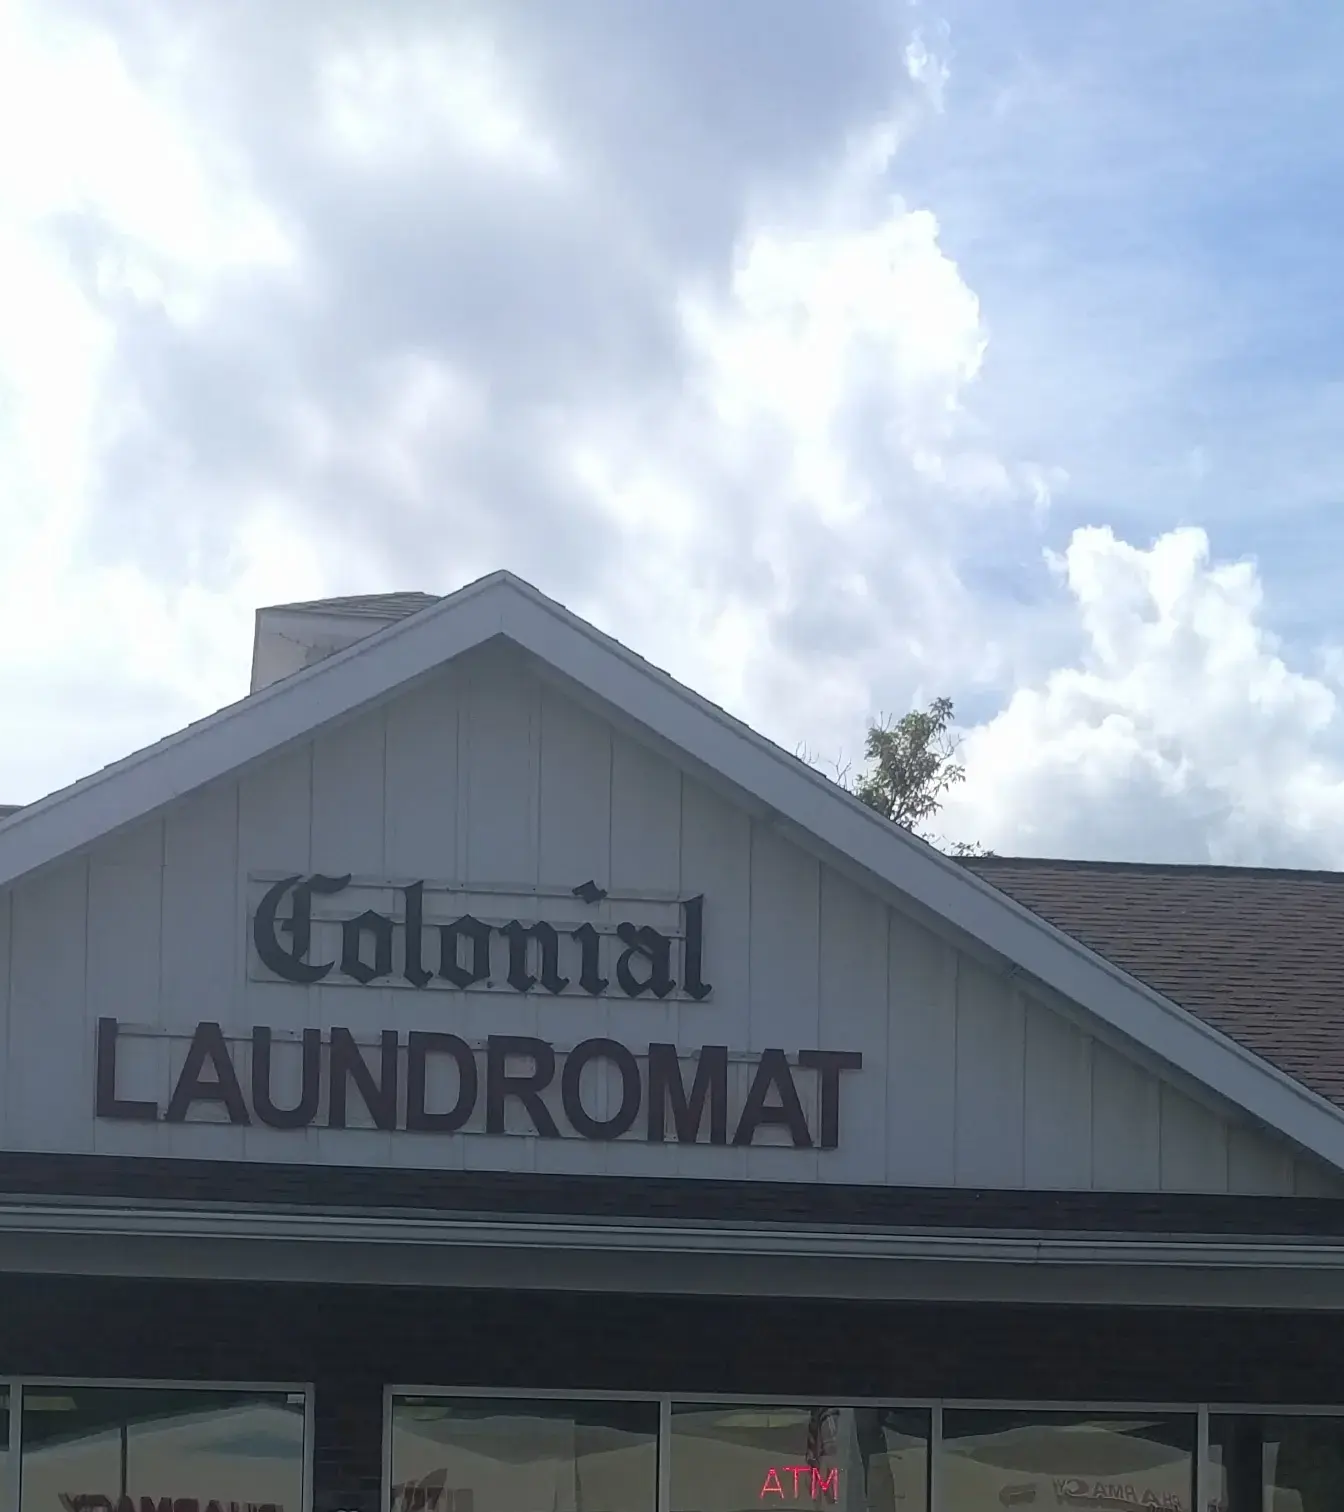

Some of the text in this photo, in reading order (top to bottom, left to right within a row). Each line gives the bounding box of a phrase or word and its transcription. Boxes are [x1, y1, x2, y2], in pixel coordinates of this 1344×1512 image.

[253, 873, 713, 1000] Colonial
[96, 1017, 863, 1149] LAUNDROMAT
[759, 1465, 840, 1503] ATM
